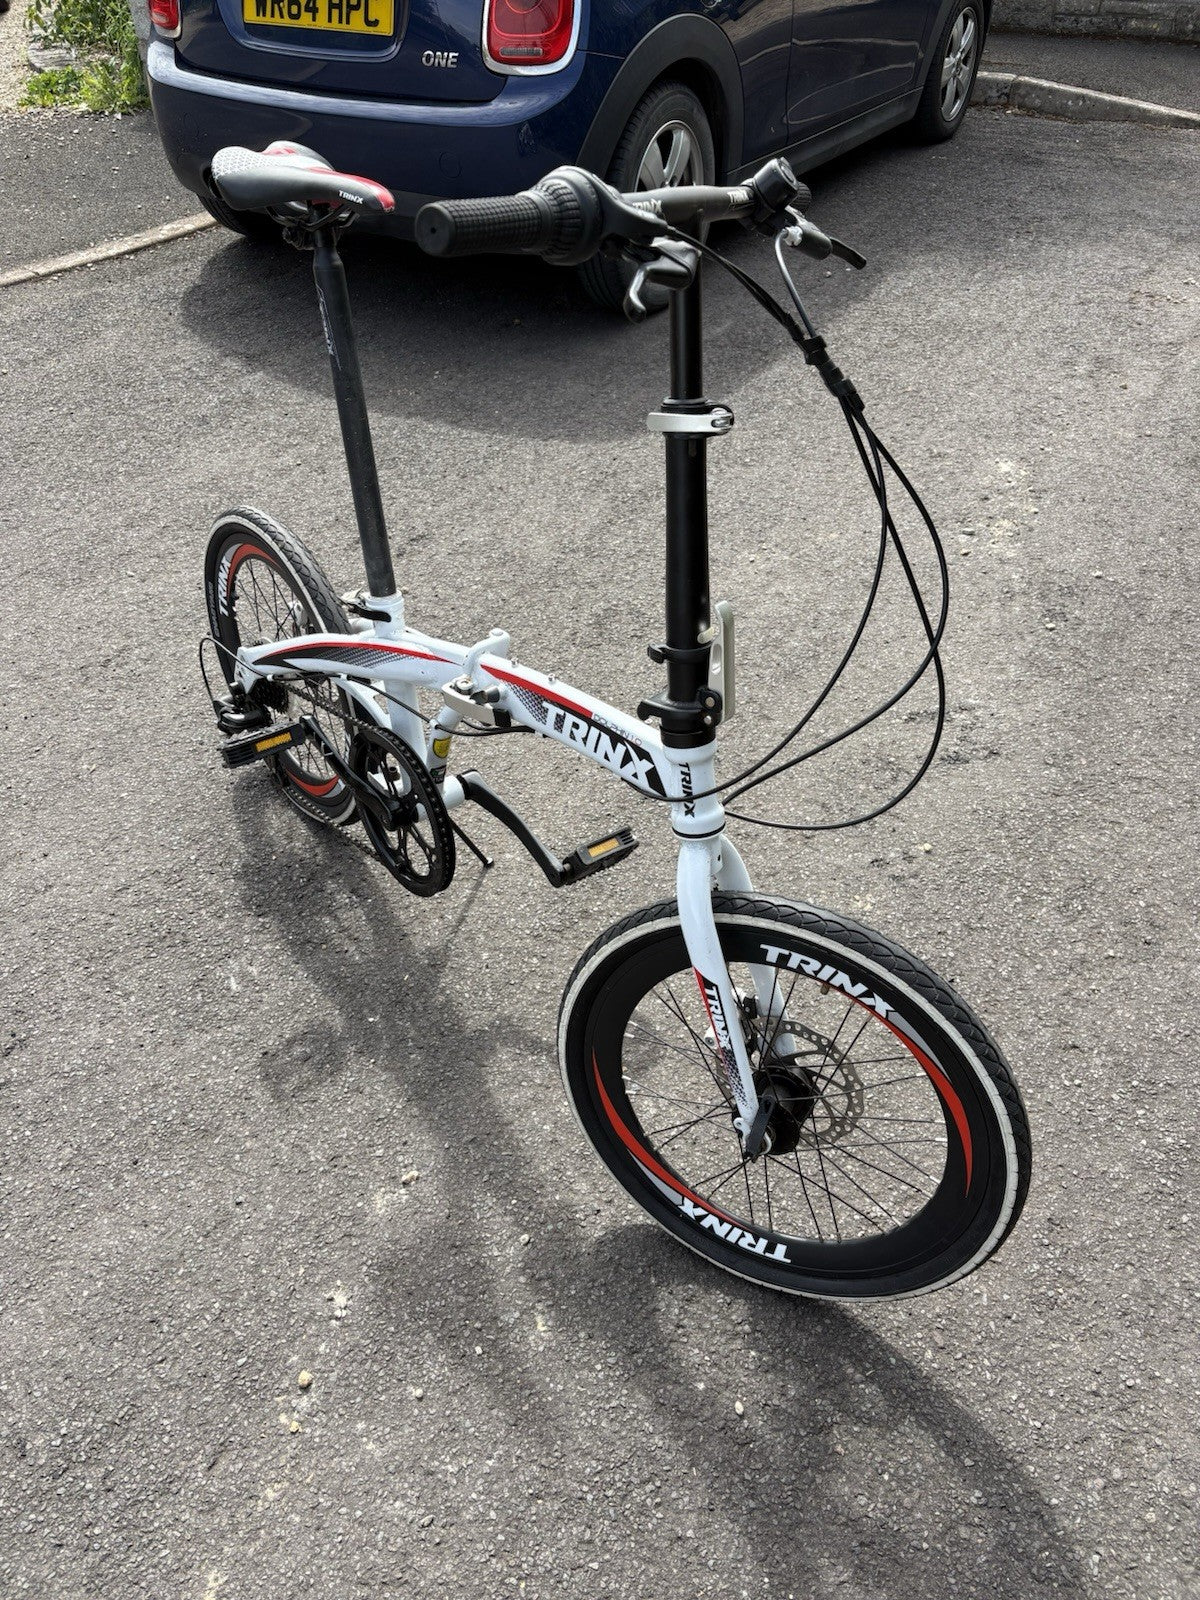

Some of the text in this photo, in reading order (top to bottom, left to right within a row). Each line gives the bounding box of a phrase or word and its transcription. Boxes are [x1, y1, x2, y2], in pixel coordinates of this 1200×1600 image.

[327, 0, 380, 27] HPC
[421, 50, 459, 68] ONE
[338, 189, 364, 204] TRINX
[218, 555, 231, 617] TRINX
[541, 701, 655, 787] TRINX
[760, 943, 895, 1019] TRINX
[704, 986, 732, 1051] TRINX
[678, 1196, 792, 1264] TRINX
